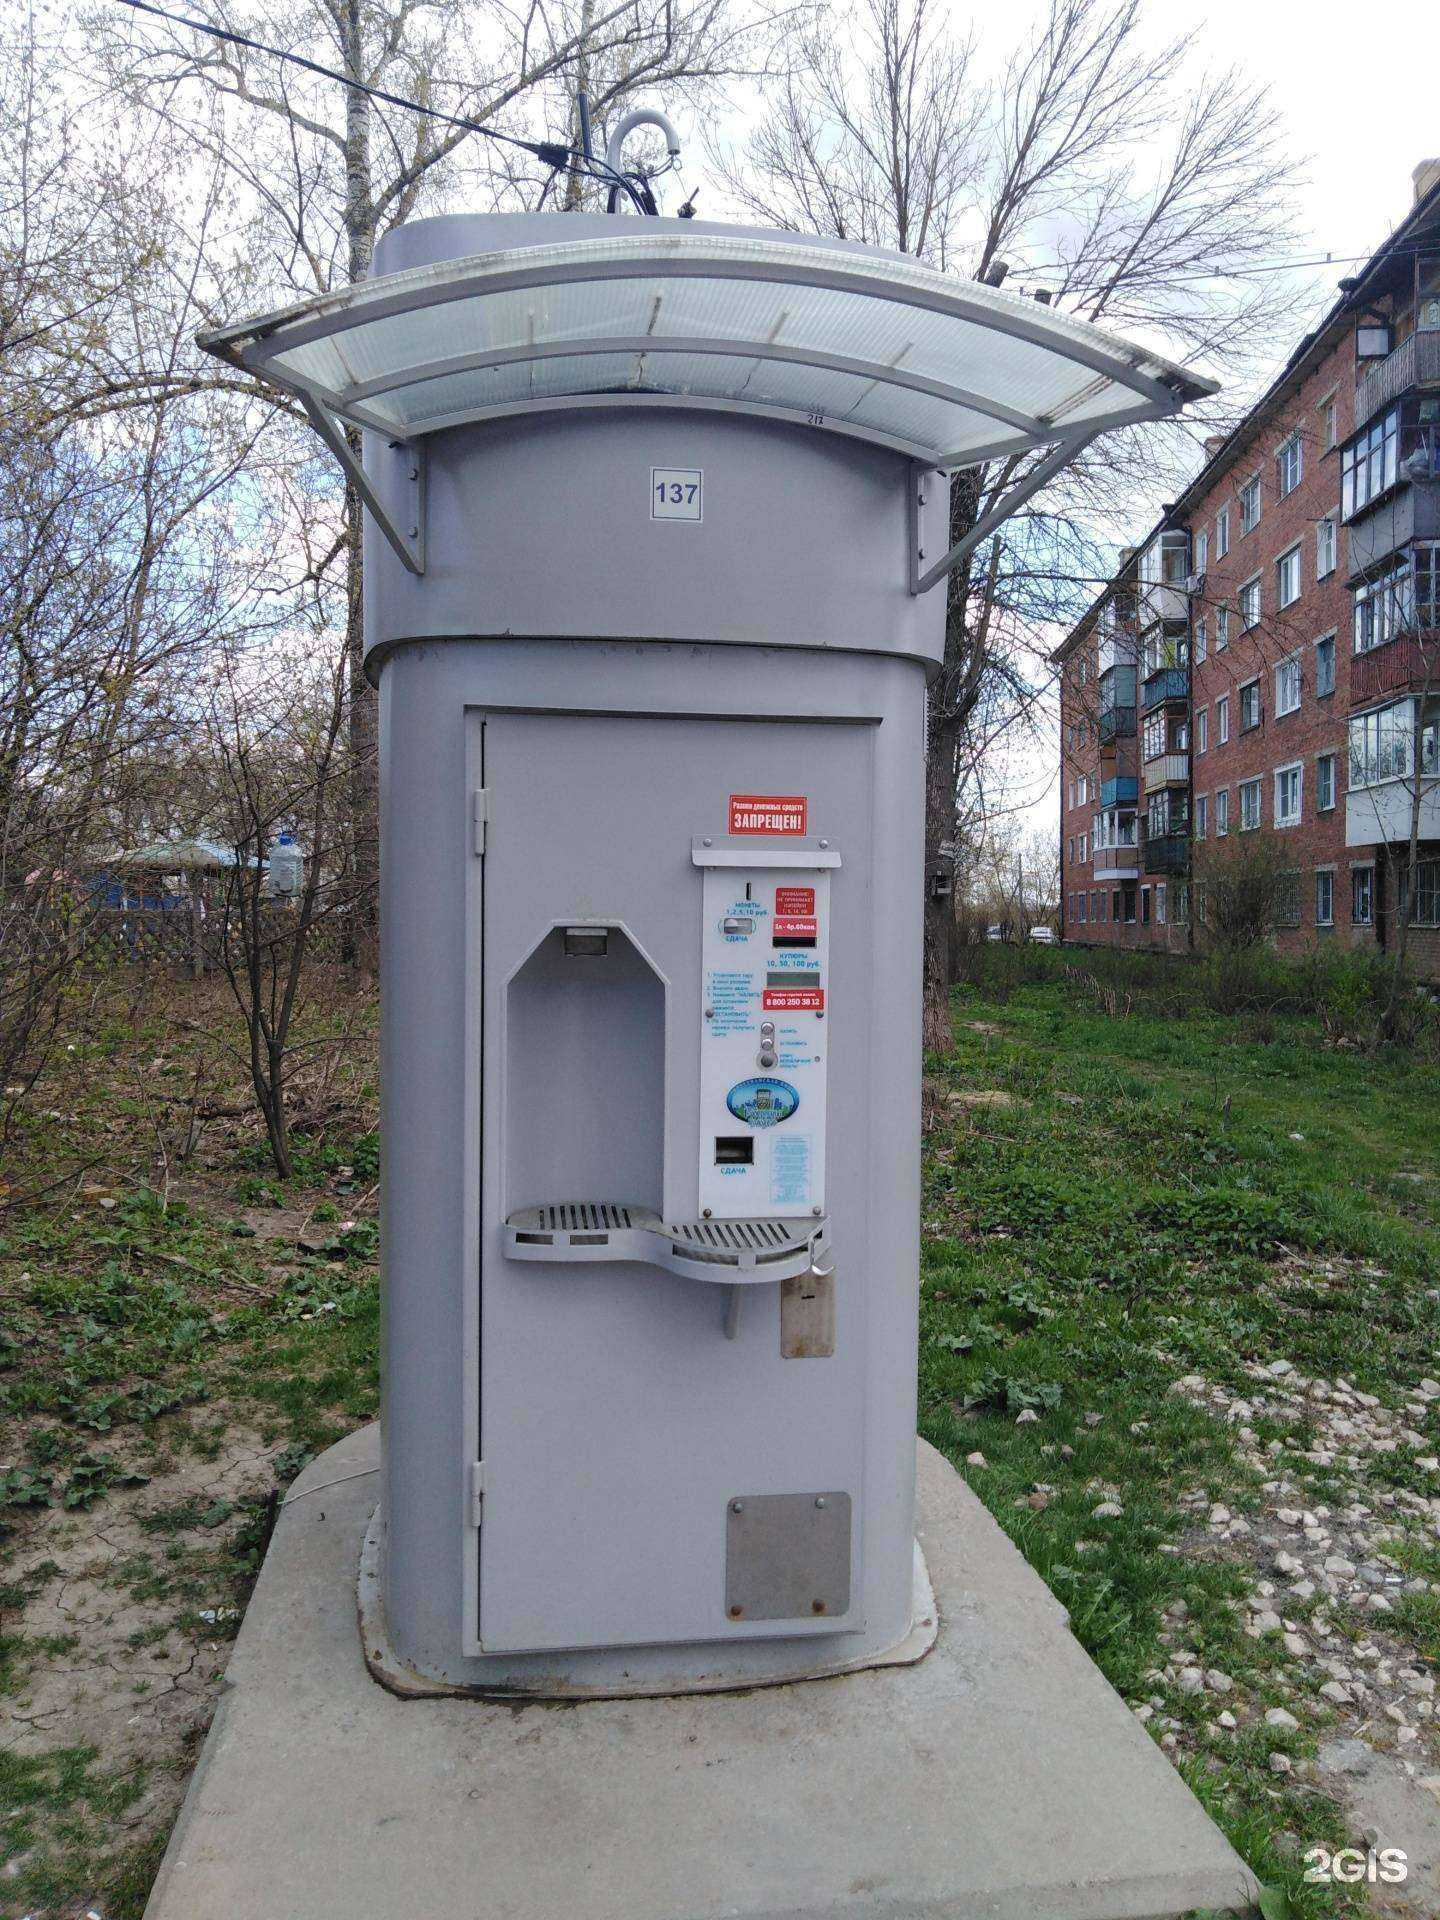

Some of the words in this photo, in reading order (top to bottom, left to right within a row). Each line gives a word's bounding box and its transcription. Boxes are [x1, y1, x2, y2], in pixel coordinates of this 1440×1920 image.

[656, 482, 698, 504] 137
[734, 813, 802, 831] ЗАПРЕЩЕН!
[720, 1167, 746, 1175] СДАЧА
